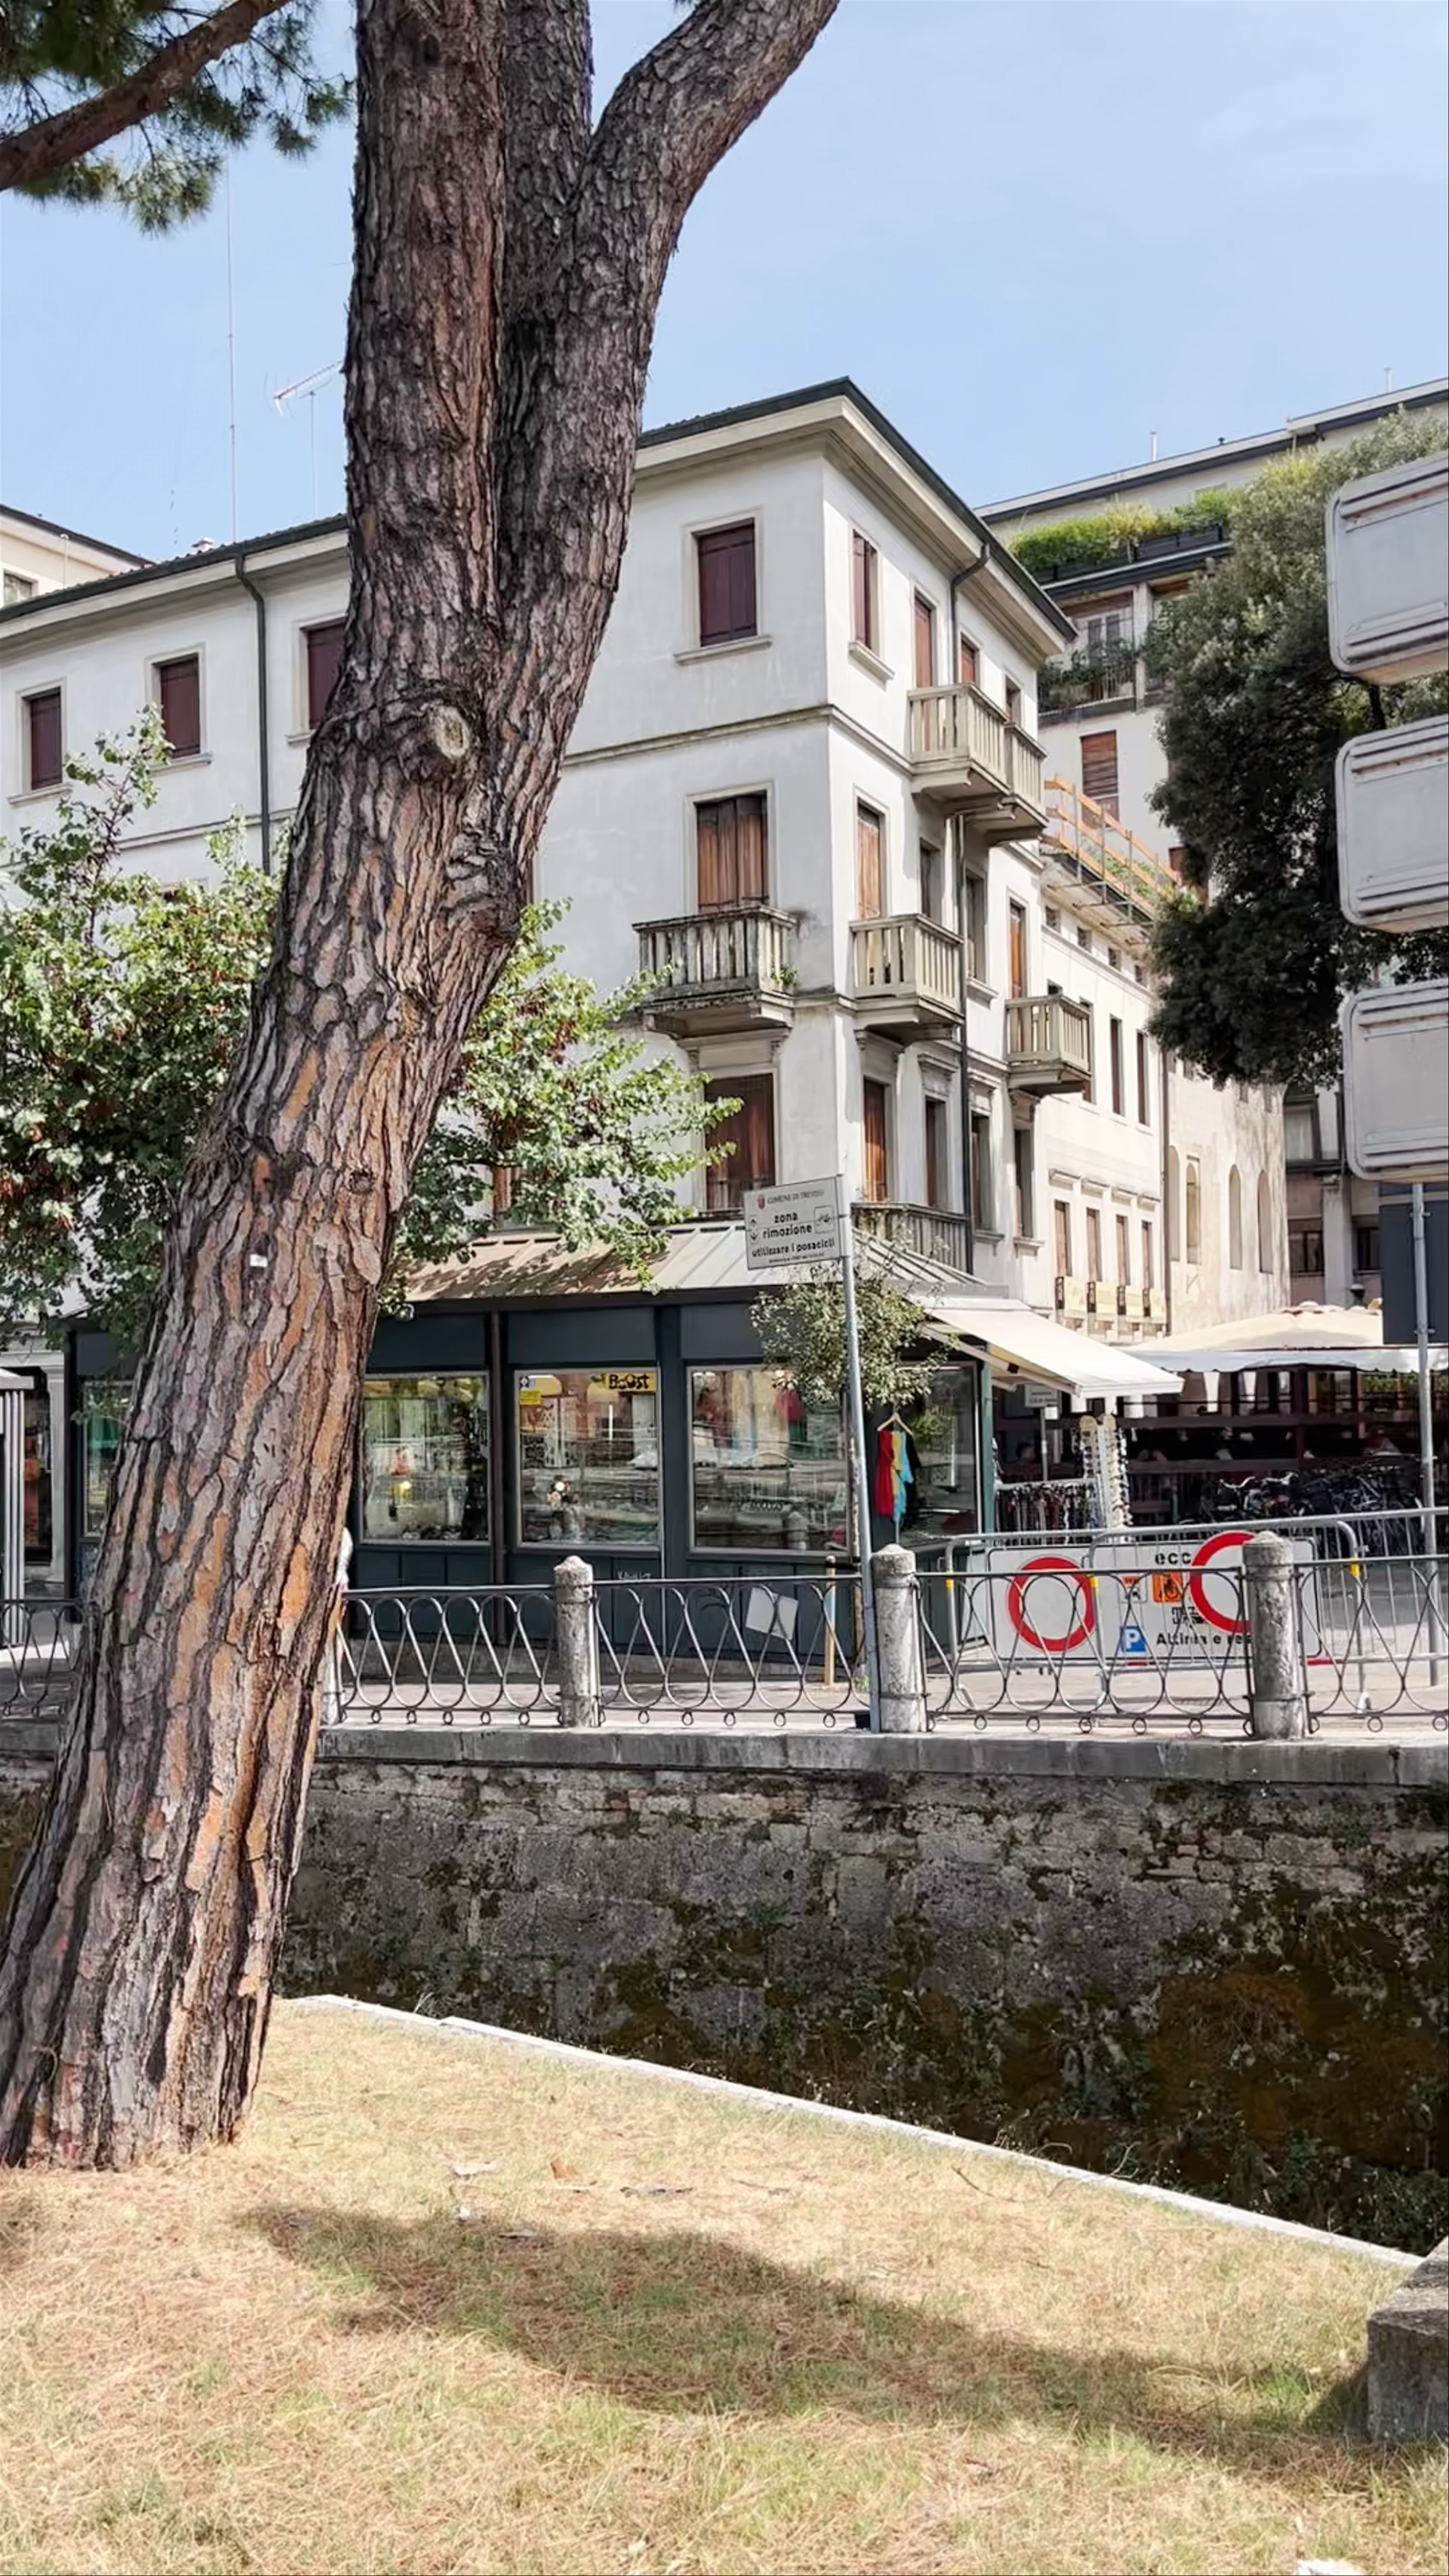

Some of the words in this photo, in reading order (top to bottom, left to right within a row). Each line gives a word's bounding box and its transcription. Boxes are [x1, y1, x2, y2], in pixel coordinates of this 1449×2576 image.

[774, 1212, 798, 1224] zona
[763, 1224, 812, 1239] rimozione
[752, 1246, 789, 1257] utilizzare
[1213, 1635, 1222, 1644] e
